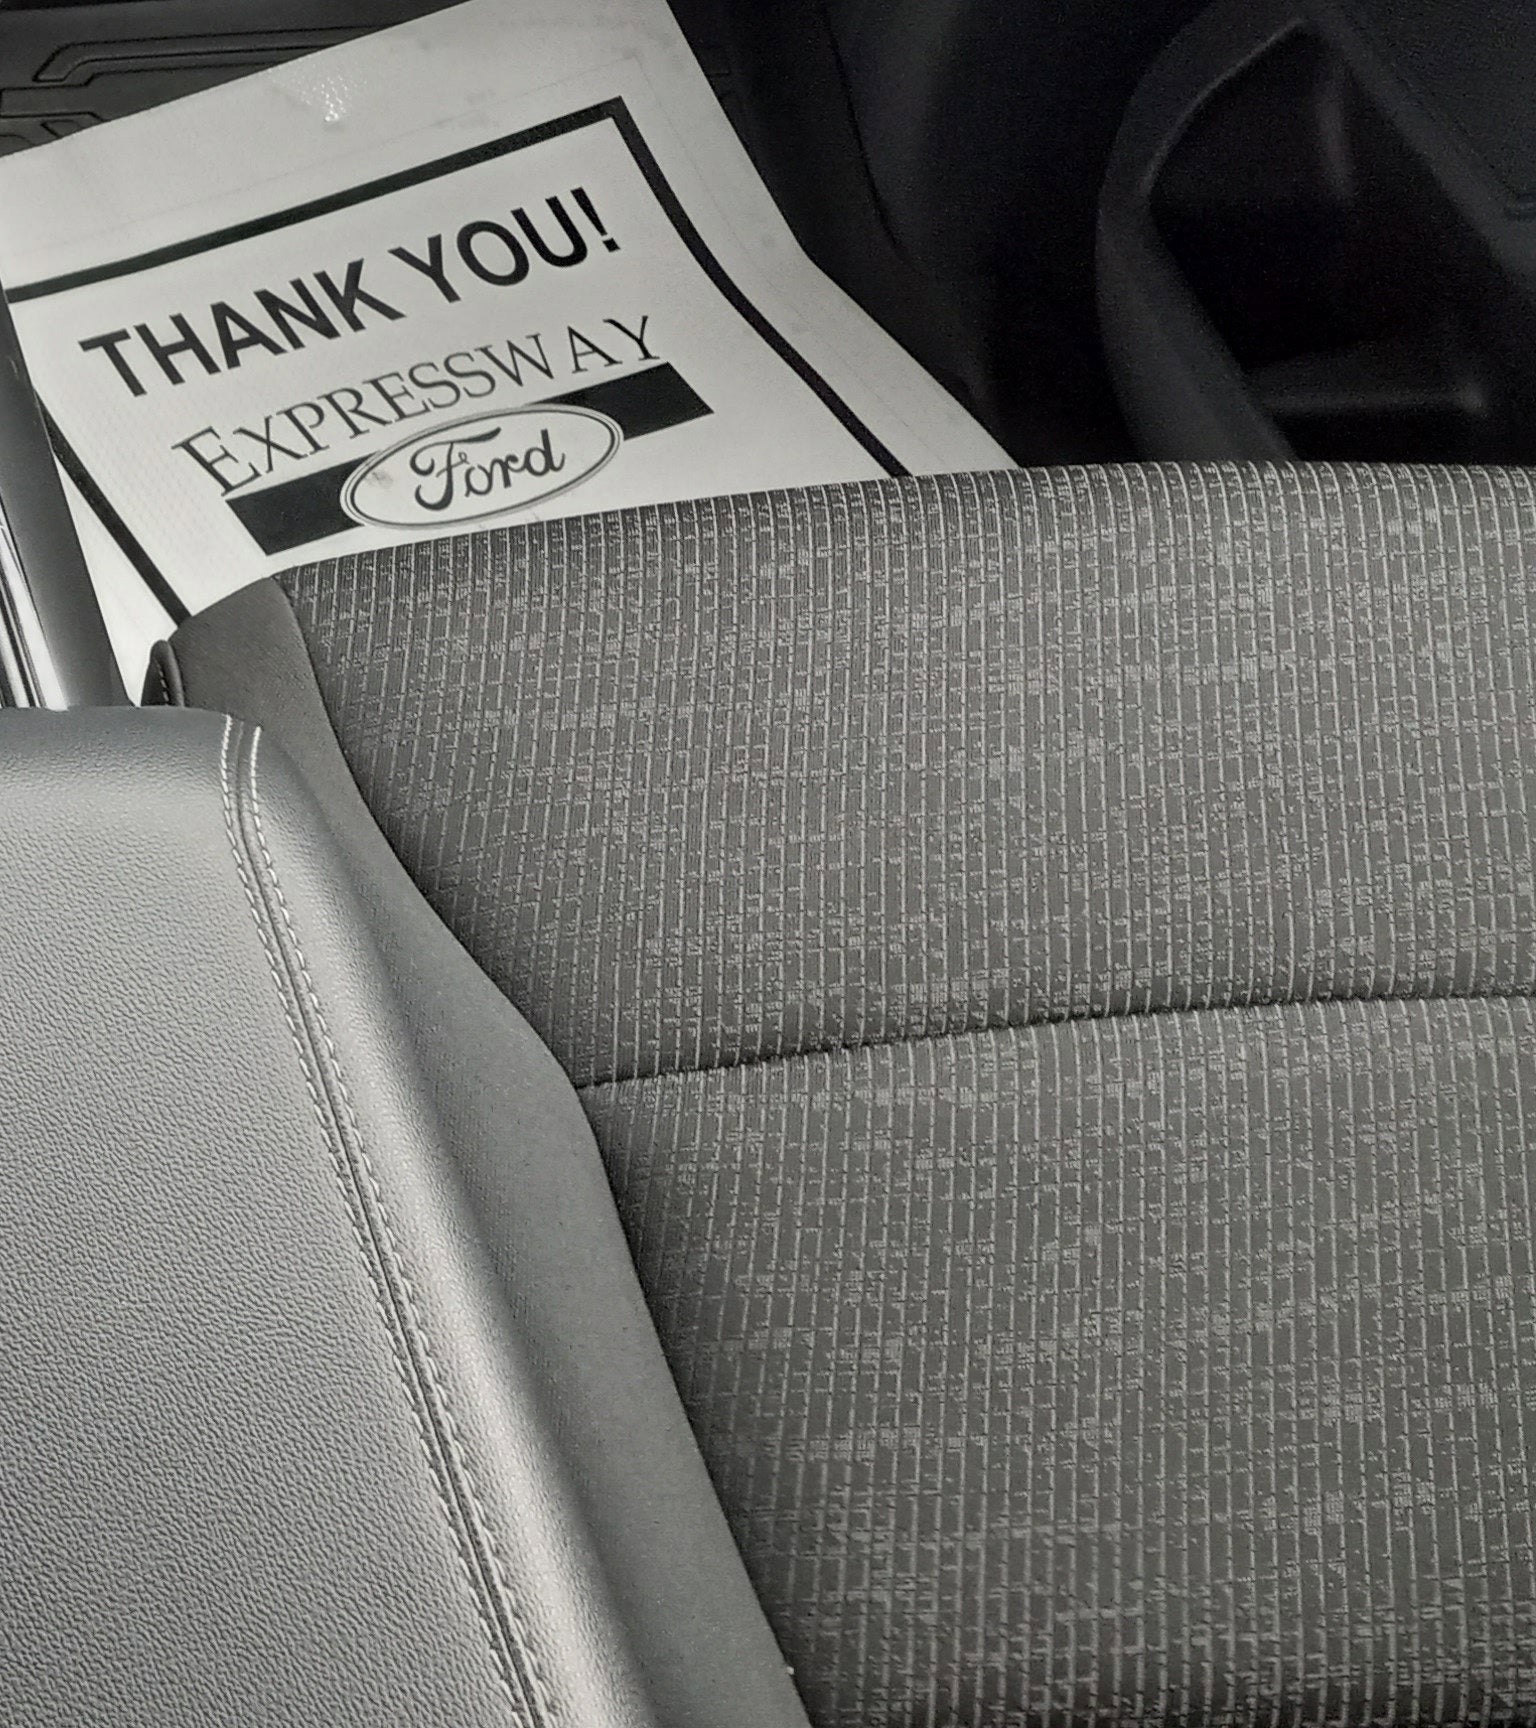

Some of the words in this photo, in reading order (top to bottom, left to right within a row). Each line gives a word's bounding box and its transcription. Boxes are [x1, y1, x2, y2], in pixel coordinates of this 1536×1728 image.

[78, 258, 407, 398] THANK
[388, 187, 621, 304] YOU!
[171, 314, 661, 496] EXPRESSWAY
[410, 425, 566, 512] Ford
